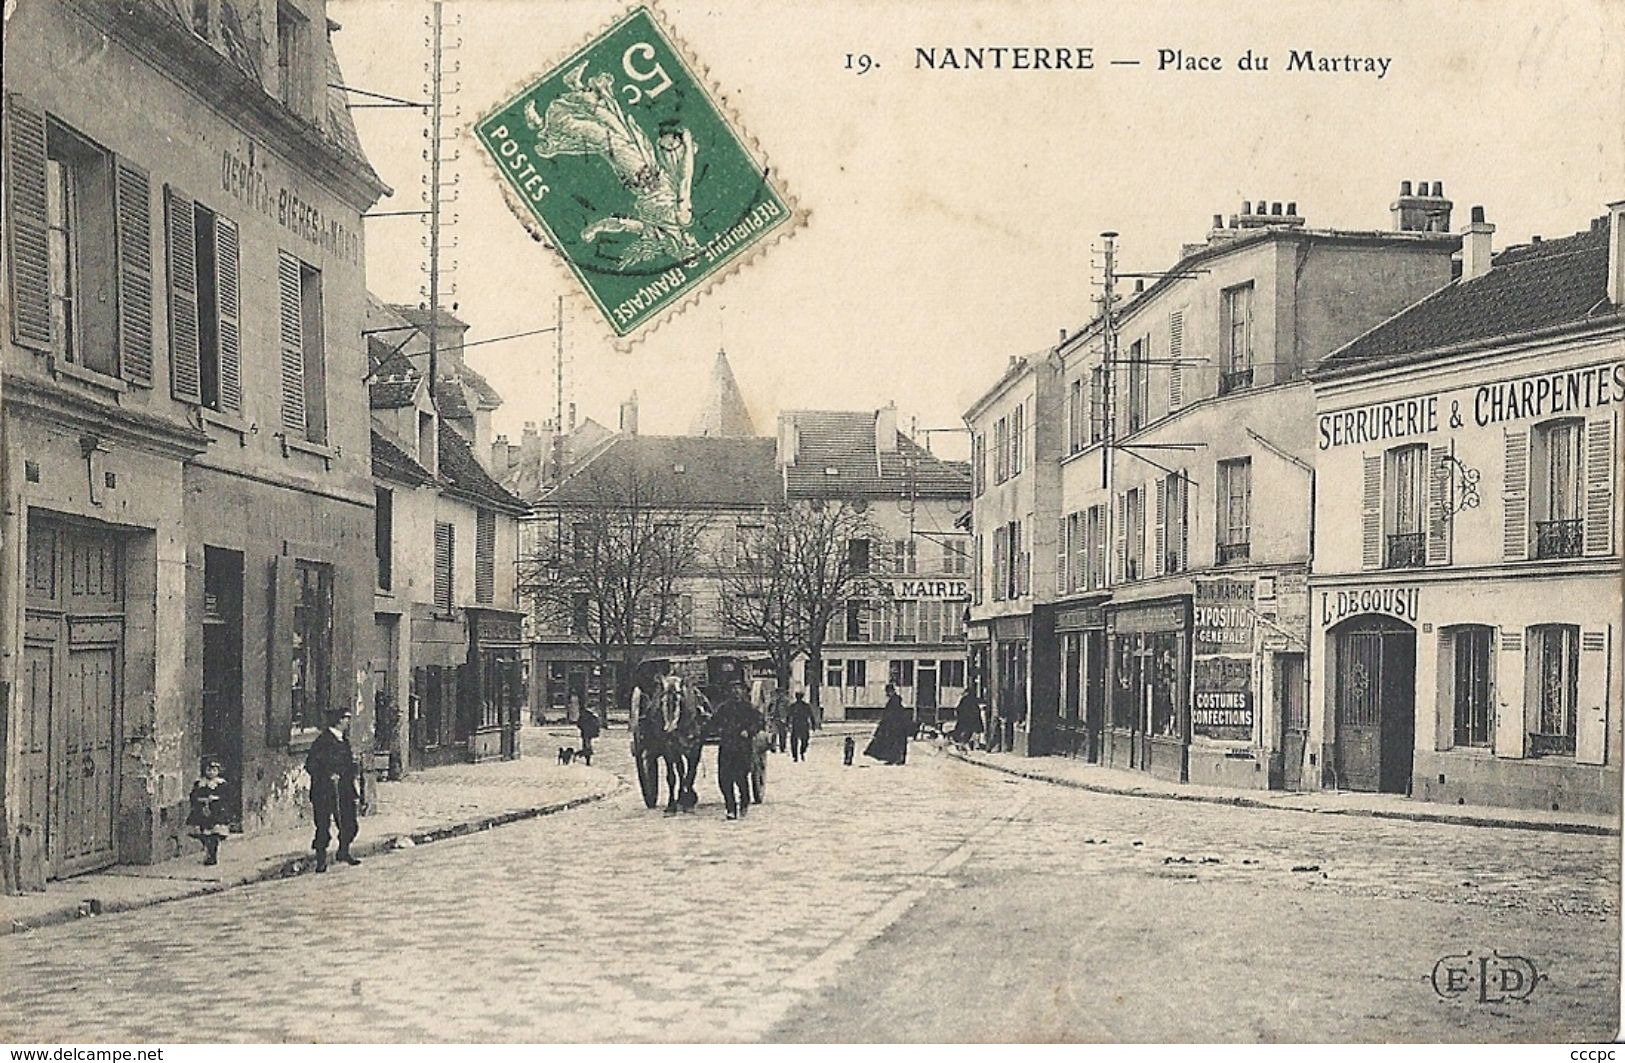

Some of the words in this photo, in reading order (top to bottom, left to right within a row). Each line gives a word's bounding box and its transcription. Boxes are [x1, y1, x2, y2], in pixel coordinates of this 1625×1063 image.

[490, 124, 551, 202] POSTES
[613, 269, 688, 324] FRANÇAISE
[1319, 397, 1439, 450] SERRURERIE
[1450, 400, 1464, 429] &
[1474, 365, 1625, 427] CHARPENTES
[901, 581, 968, 597] MAIRIE
[1194, 606, 1254, 628] EXPOSITION
[1196, 693, 1246, 709] COSTUMES
[1193, 709, 1253, 725] CONFECTIONS
